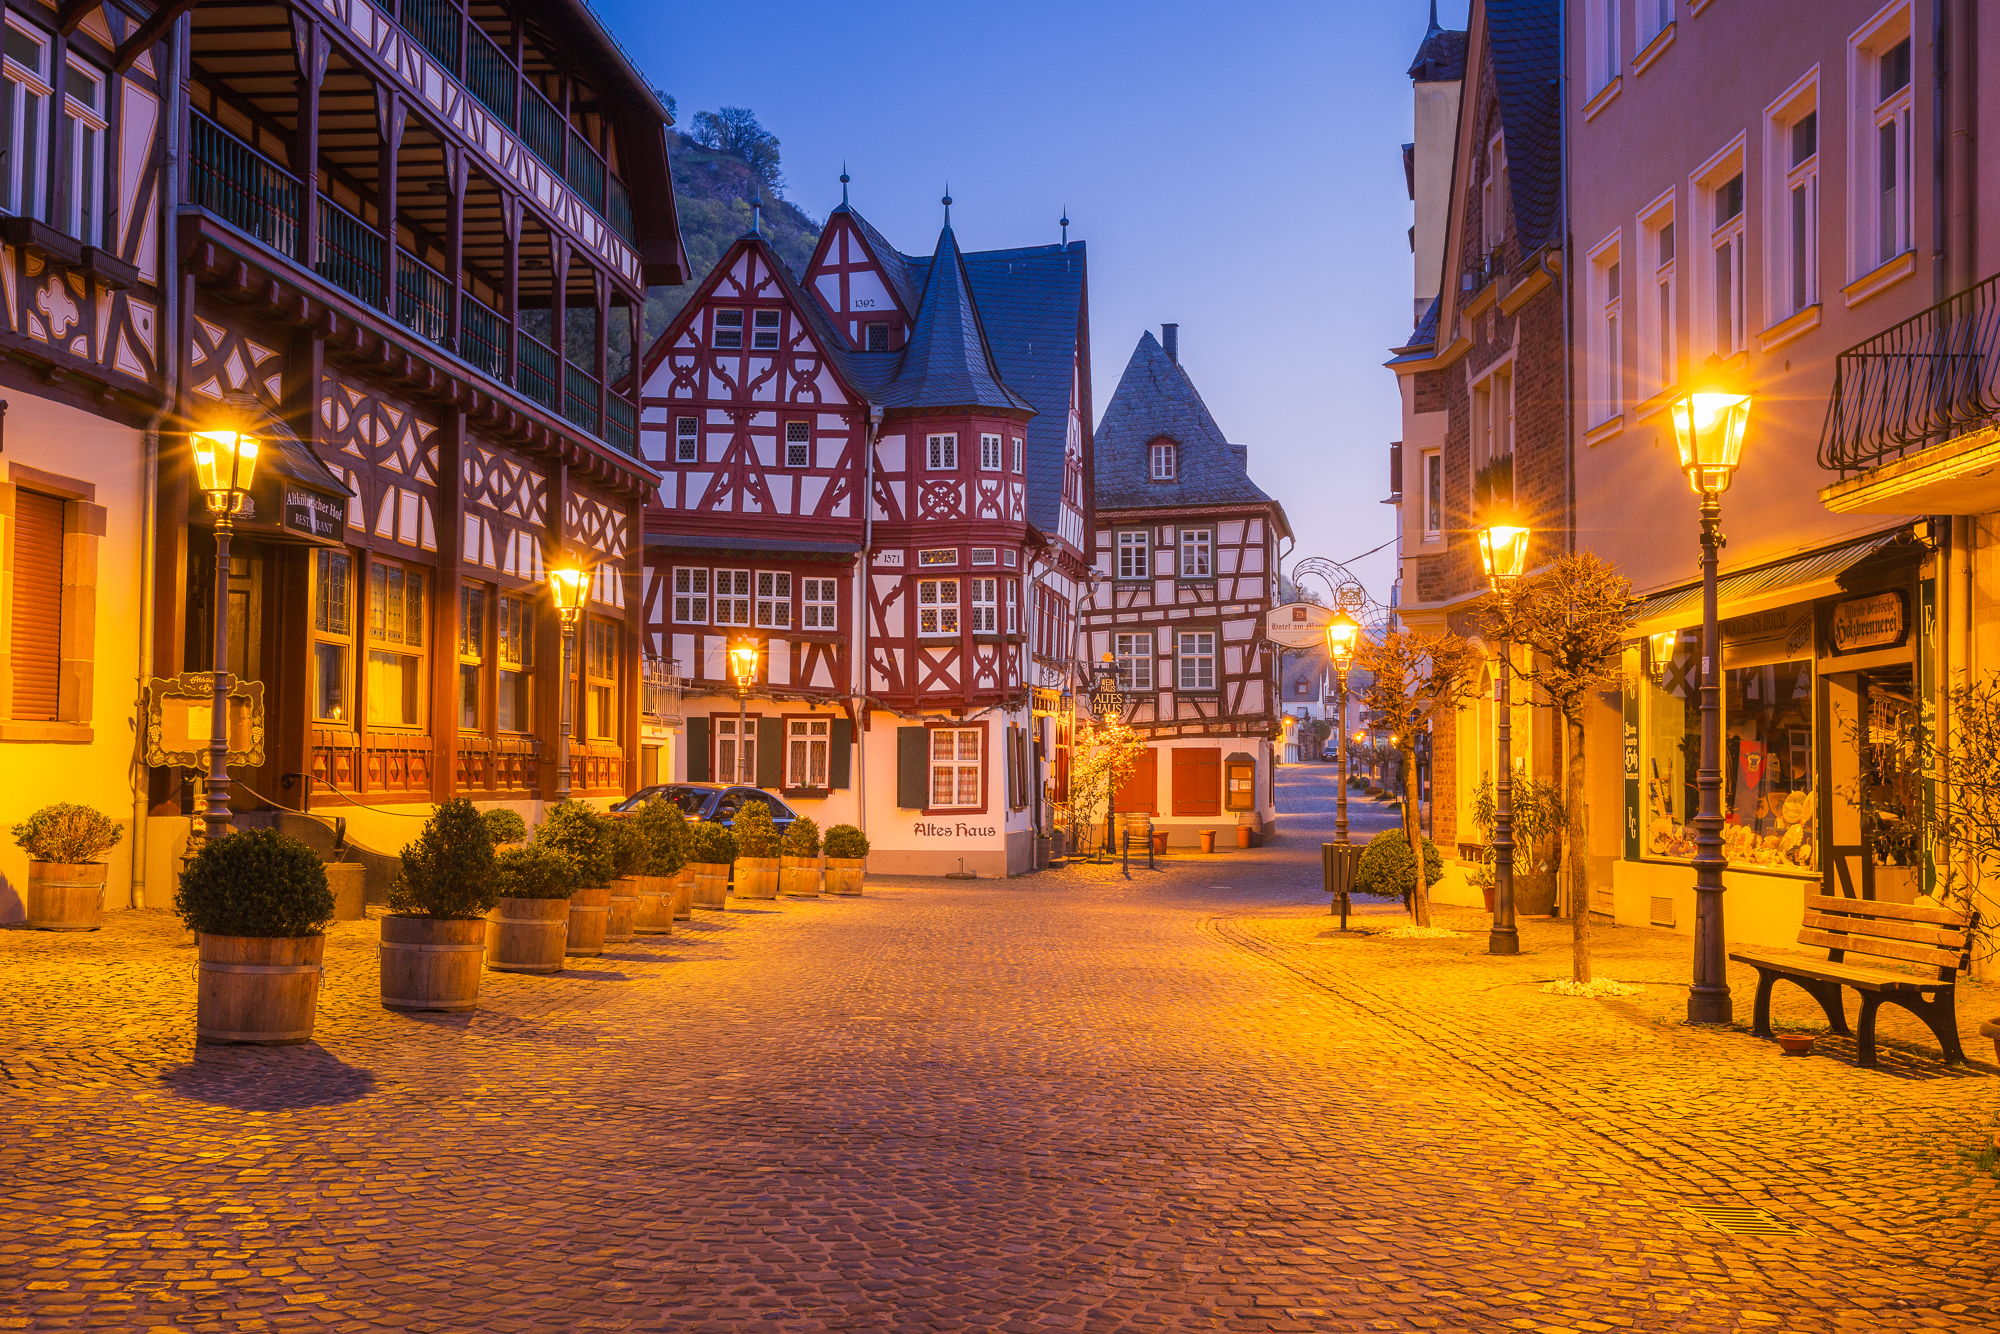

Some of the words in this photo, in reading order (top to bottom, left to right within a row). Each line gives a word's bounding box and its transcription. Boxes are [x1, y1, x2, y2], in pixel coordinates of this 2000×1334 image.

[855, 299, 875, 308] 1392
[329, 503, 343, 521] Hof
[883, 554, 900, 563] 1571
[1271, 622, 1291, 630] Hotel
[1836, 611, 1897, 645] Holzbrennerei
[1101, 678, 1115, 686] WEIN
[1093, 693, 1123, 704] ALTES
[1093, 703, 1122, 714] HAUS
[914, 822, 953, 837] Altes
[955, 822, 996, 837] Haus
